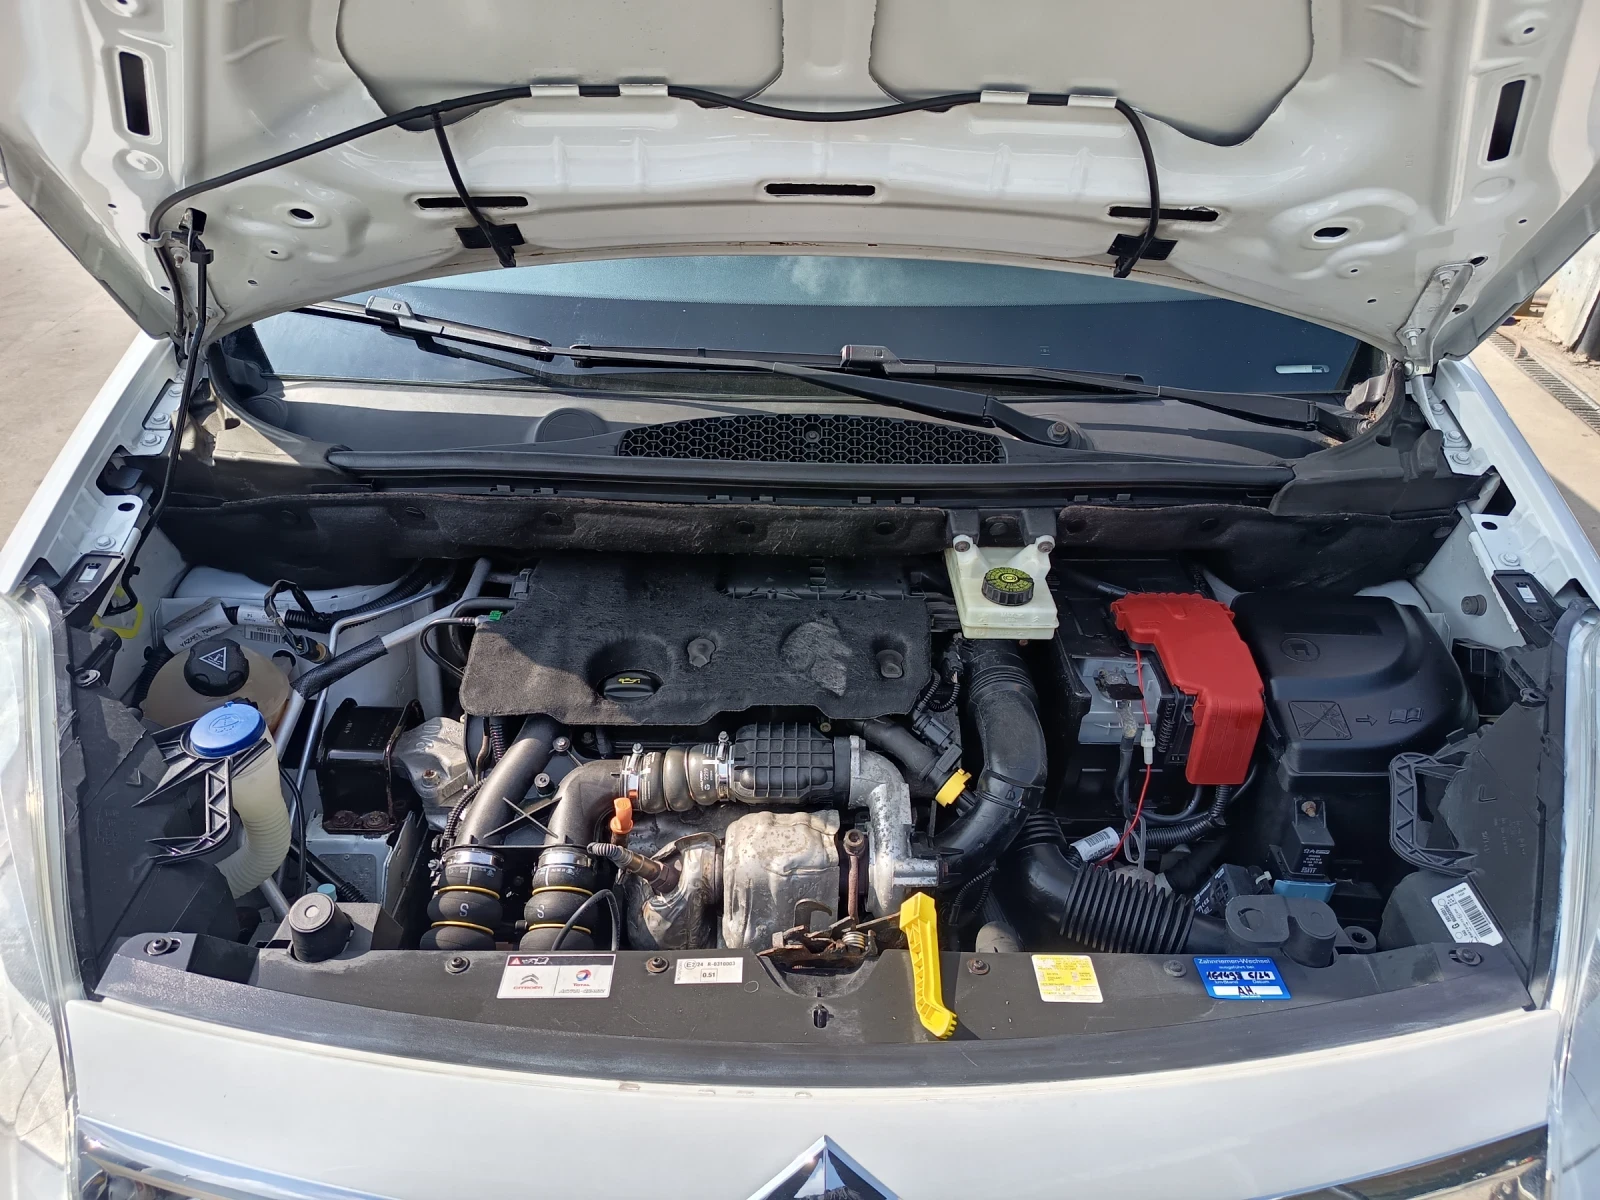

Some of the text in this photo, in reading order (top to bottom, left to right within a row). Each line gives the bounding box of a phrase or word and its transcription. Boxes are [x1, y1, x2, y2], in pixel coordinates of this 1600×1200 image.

[179, 633, 199, 647] YAZAKI
[459, 903, 469, 917] S
[536, 904, 545, 919] S
